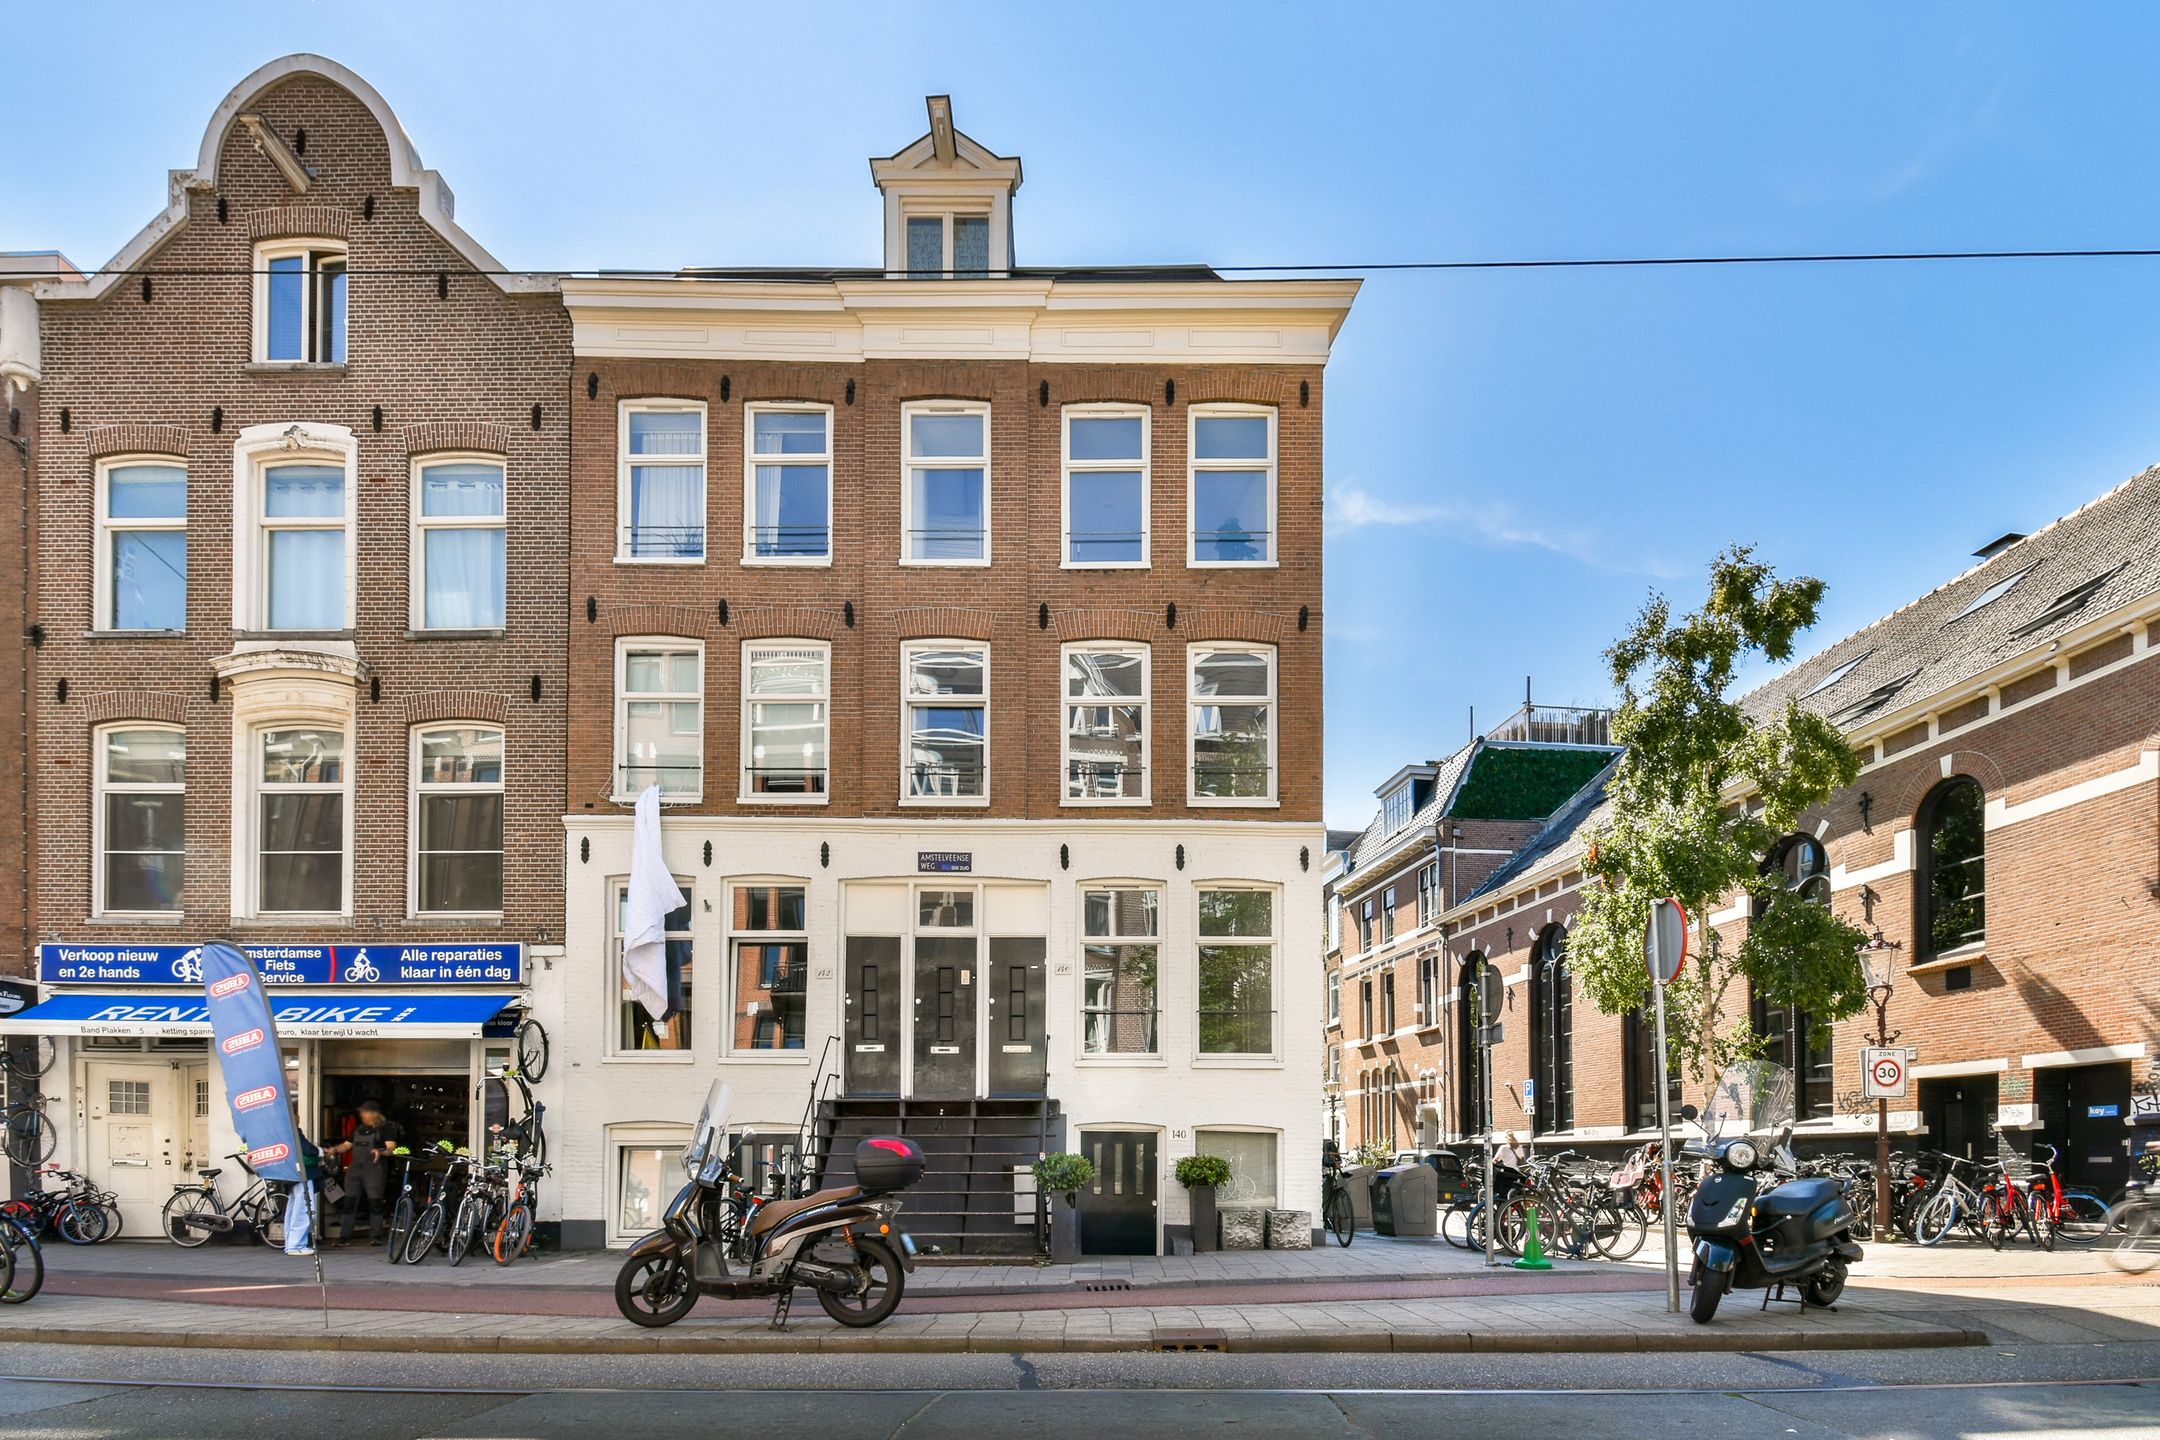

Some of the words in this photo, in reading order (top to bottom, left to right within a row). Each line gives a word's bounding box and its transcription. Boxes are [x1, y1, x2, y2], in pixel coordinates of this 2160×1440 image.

[920, 853, 969, 862] AMSTELVEENSE
[920, 862, 935, 870] WEG
[58, 949, 115, 964] Verkoop
[117, 950, 159, 962] nieuw
[246, 947, 322, 959] msterdamse
[400, 949, 428, 962] Alle
[431, 949, 503, 964] reparaties
[265, 959, 296, 971] Fiets
[58, 968, 76, 978] en
[78, 966, 96, 978] 2e
[98, 966, 141, 979] hands
[401, 967, 436, 979] klaar
[439, 966, 453, 978] in
[455, 966, 481, 978] één
[484, 966, 512, 980] dag
[274, 1007, 392, 1022] BIKE
[80, 1026, 99, 1034] Band
[101, 1025, 132, 1034] Plakken
[161, 1025, 188, 1036] ketting
[301, 1027, 319, 1036] klaar
[321, 1027, 346, 1038] terwijl
[347, 1028, 354, 1036] U
[354, 1027, 378, 1036] wacht
[1878, 1067, 1896, 1078] 30
[1525, 1082, 1532, 1095] P
[1172, 1129, 1187, 1139] 140
